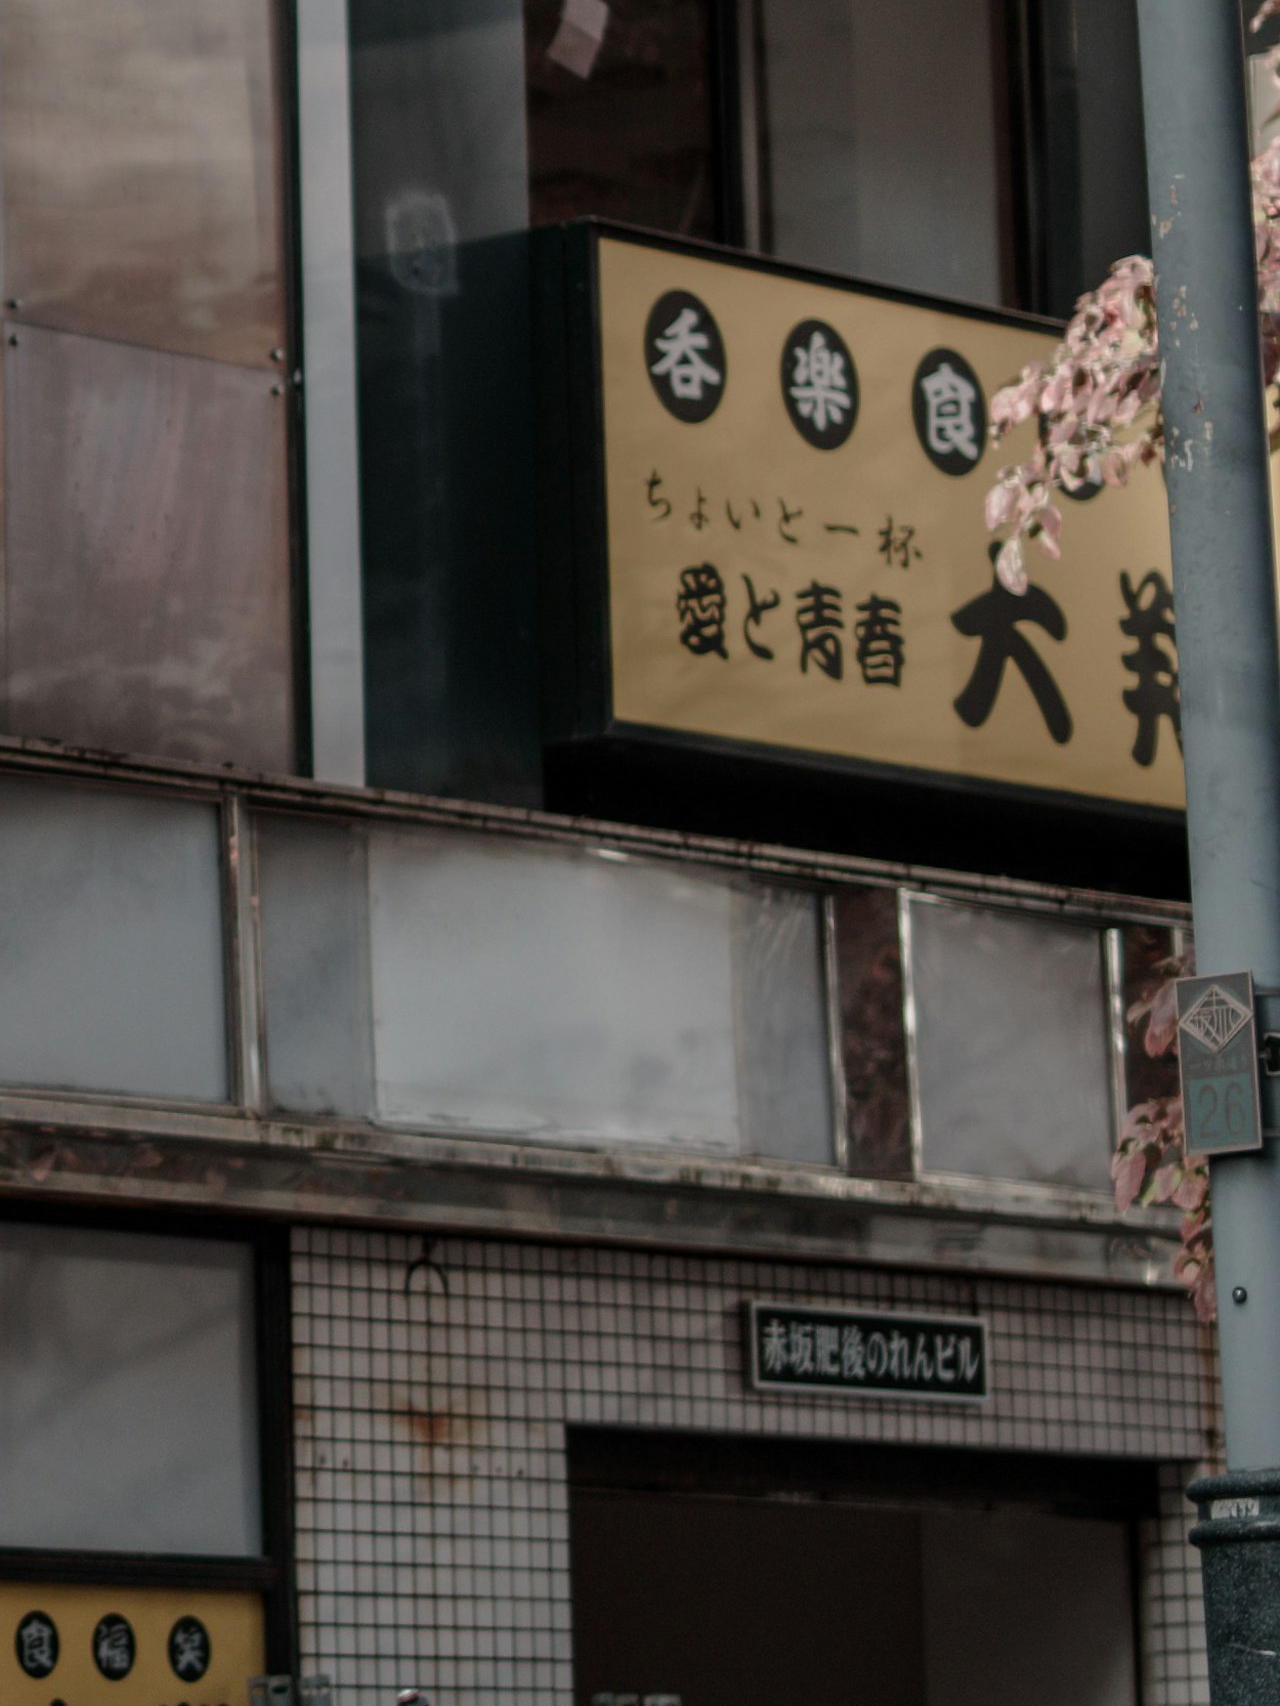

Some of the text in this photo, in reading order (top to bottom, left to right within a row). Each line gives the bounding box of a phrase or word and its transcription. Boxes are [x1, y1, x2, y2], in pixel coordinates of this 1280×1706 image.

[643, 468, 924, 571] ちょいと一杯
[1197, 1081, 1247, 1141] 26
[762, 1318, 980, 1384] 赤坂肥後のれんビル
